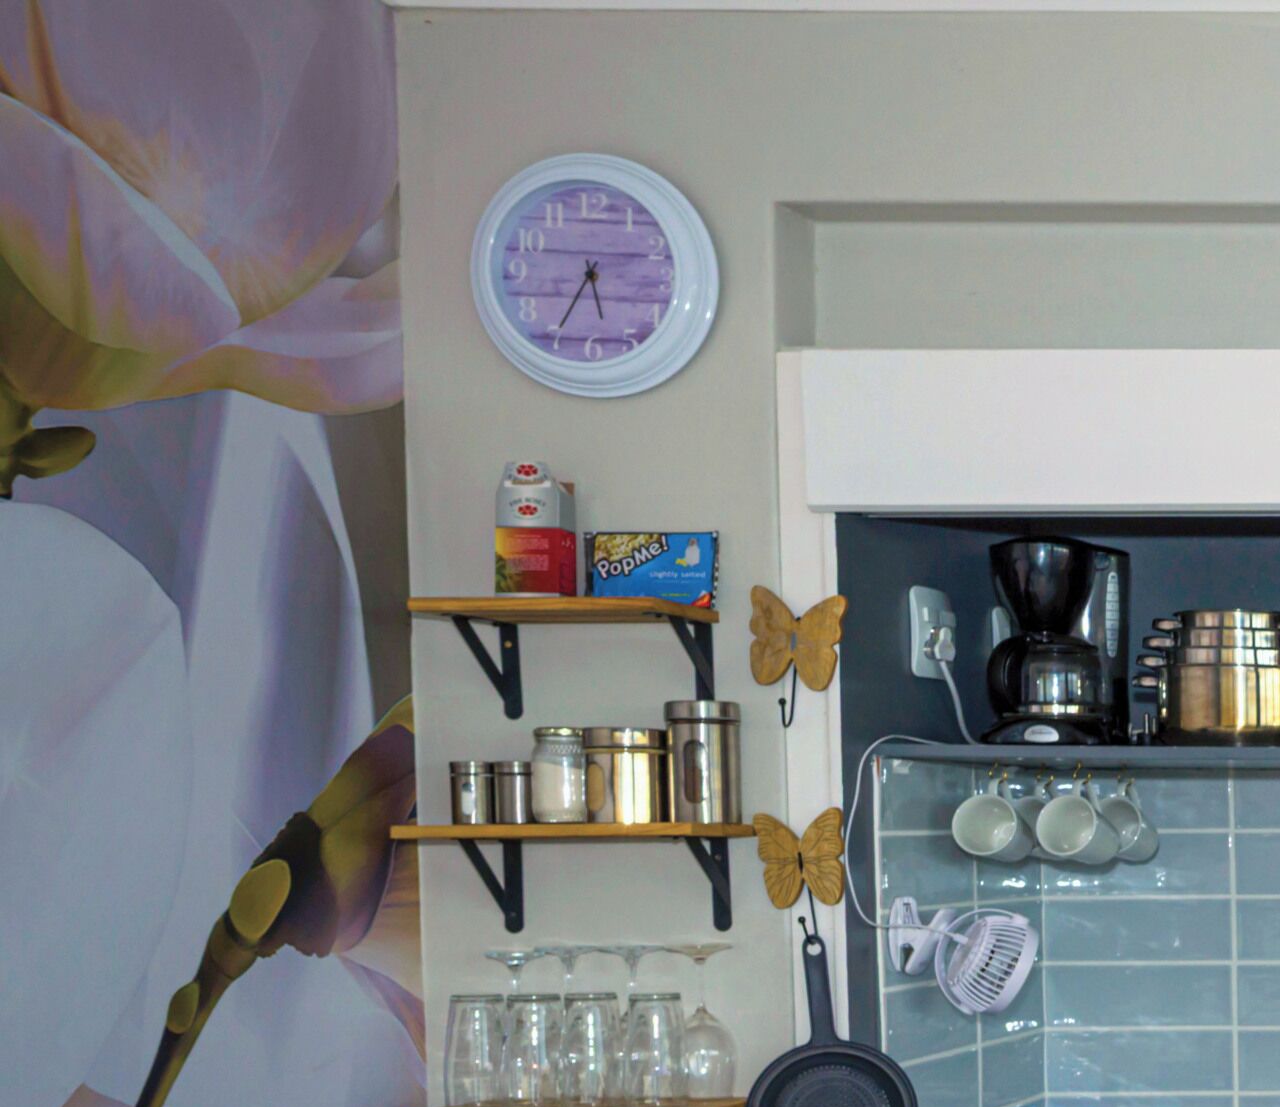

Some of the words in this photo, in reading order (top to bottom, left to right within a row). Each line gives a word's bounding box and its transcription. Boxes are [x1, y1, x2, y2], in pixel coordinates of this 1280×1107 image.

[545, 203, 564, 228] 11
[578, 192, 608, 219] 12
[625, 207, 633, 232] 1
[518, 228, 545, 254] 10
[648, 235, 665, 260] 2
[509, 259, 527, 283] 9
[659, 268, 673, 292] 3
[518, 297, 537, 321] 8
[647, 303, 661, 329] 4
[547, 325, 562, 351] 7
[584, 334, 603, 361] 6
[622, 329, 639, 352] 5
[597, 534, 669, 579] PopMe!
